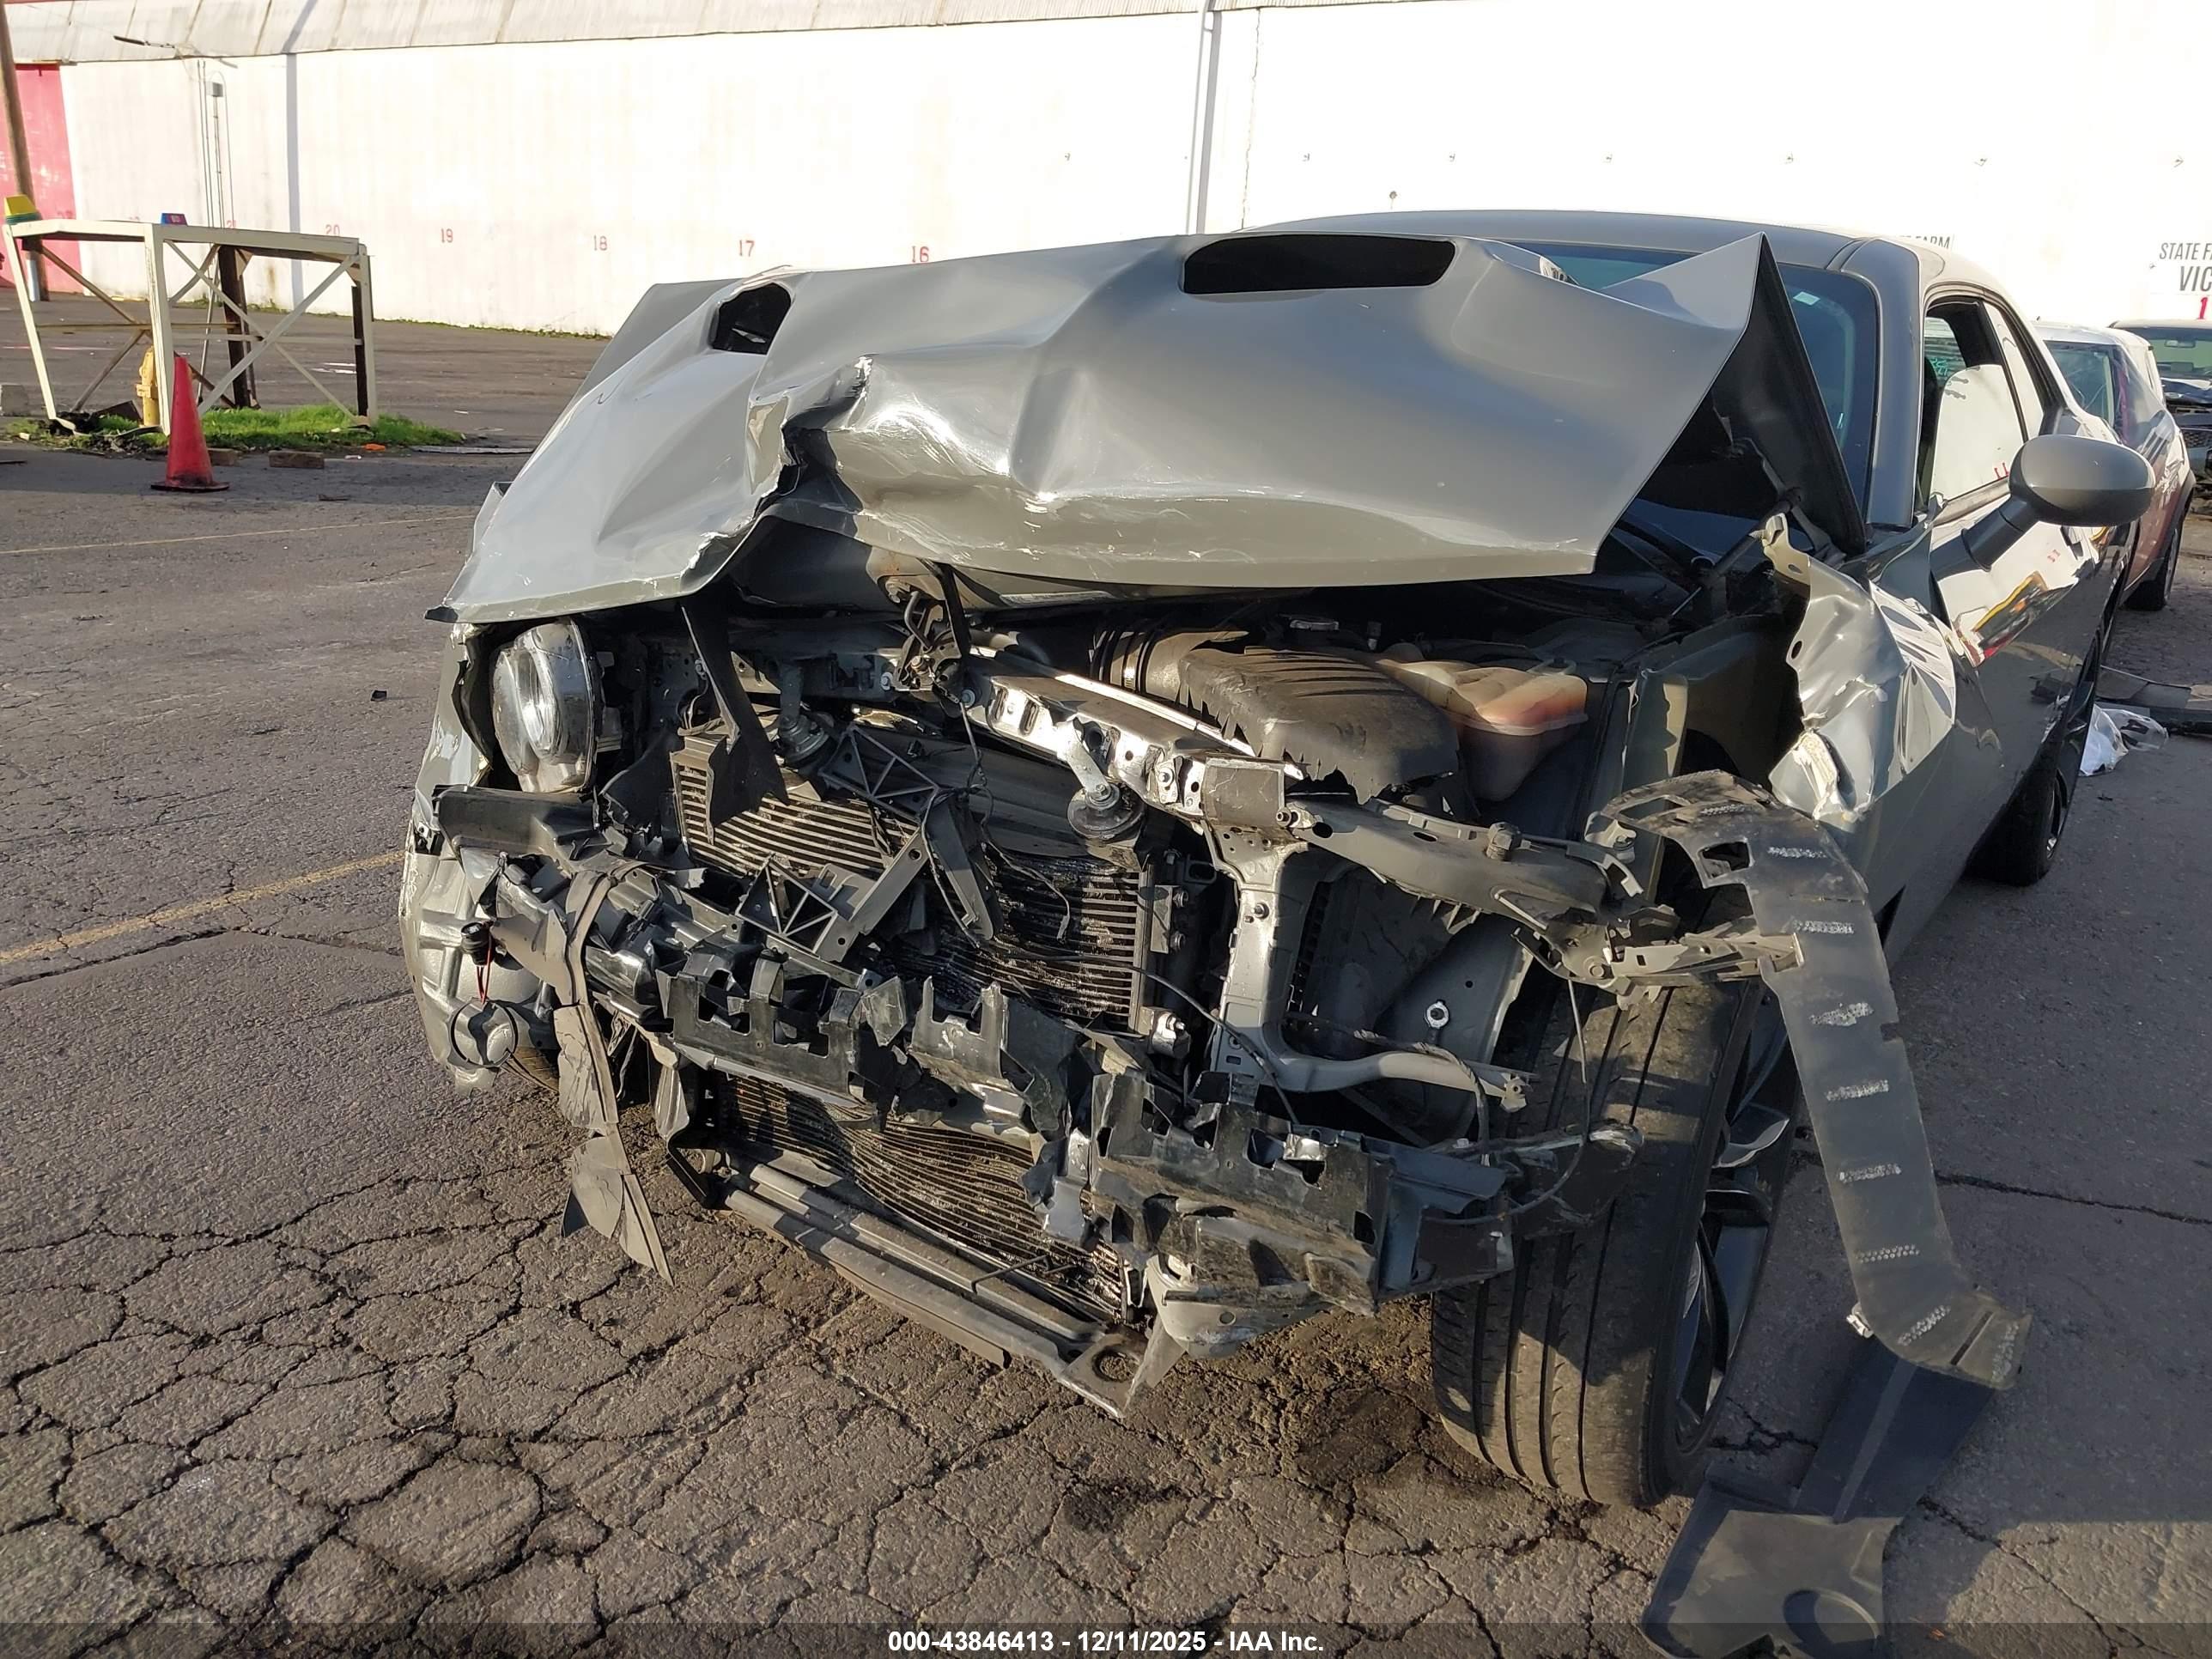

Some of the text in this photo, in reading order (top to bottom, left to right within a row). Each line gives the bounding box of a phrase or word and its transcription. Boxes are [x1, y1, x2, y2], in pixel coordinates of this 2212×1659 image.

[441, 228, 453, 243] 19
[593, 235, 607, 251] 18
[739, 240, 754, 257] 17
[911, 246, 929, 263] 16
[2159, 242, 2200, 260] STATE
